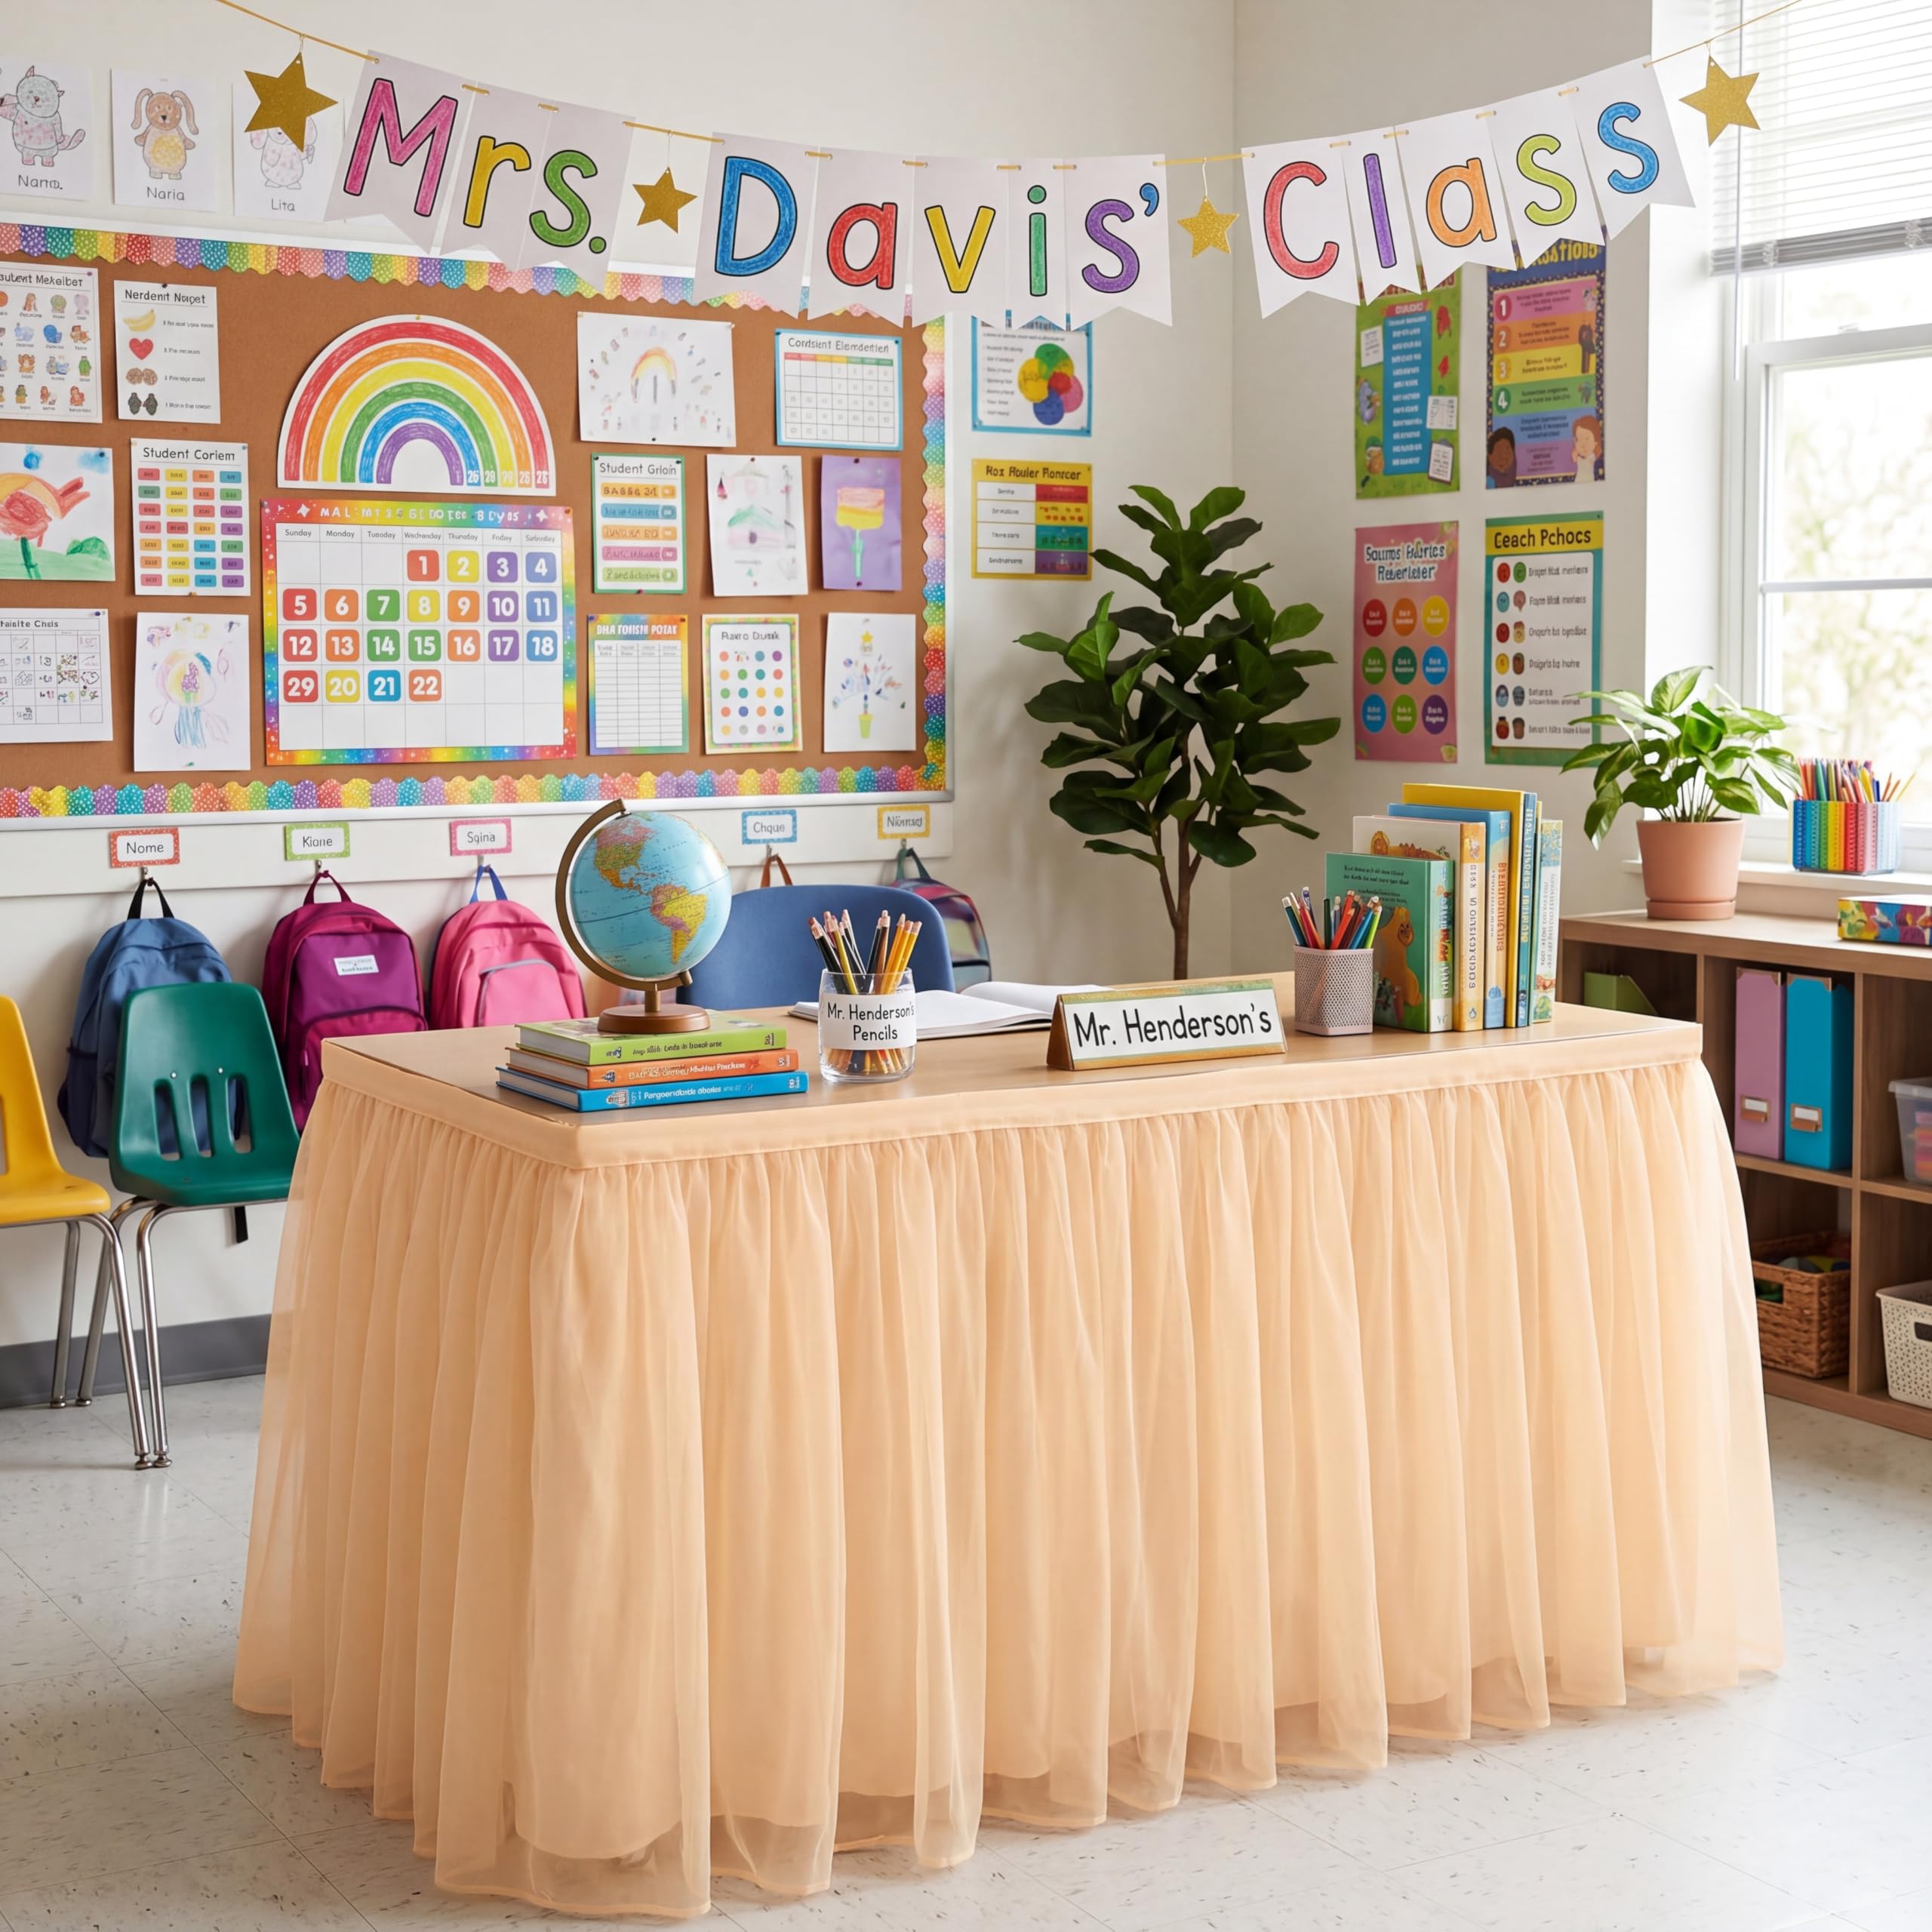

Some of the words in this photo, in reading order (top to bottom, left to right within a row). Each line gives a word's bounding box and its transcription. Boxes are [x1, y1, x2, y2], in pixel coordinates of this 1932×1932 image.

[343, 78, 606, 254] Mrs.
[1263, 102, 1660, 280] Class
[146, 186, 184, 201] Naria
[272, 199, 295, 212] Lita
[1500, 300, 1506, 316] 1
[1499, 331, 1506, 347] 2
[1498, 392, 1508, 408] 4
[143, 447, 189, 460] Student
[600, 463, 643, 474] Student
[285, 529, 312, 537] Sunday
[419, 555, 428, 575] 1
[457, 556, 469, 577] 2
[497, 557, 509, 577] 3
[534, 557, 548, 576] 4
[294, 595, 307, 616] 5
[335, 595, 349, 616] 6
[377, 595, 390, 615] 7
[418, 595, 432, 616] 8
[457, 596, 471, 616] 9
[492, 596, 515, 617] 10
[533, 597, 551, 617] 11
[289, 635, 312, 656] 12
[331, 635, 354, 656] 13
[372, 635, 395, 656] 14
[414, 635, 436, 657] 15
[454, 636, 476, 656] 16
[492, 636, 514, 655] 17
[532, 635, 555, 656] 18
[288, 677, 315, 697] 29
[330, 676, 357, 697] 20
[374, 676, 395, 697] 21
[413, 675, 438, 695] 22
[127, 841, 165, 854] Nome
[827, 1002, 844, 1020] Mr.
[849, 1002, 915, 1021] Henderson's
[853, 1024, 898, 1041] Pencils
[1073, 1011, 1116, 1048] Mr.
[1123, 1003, 1272, 1044] Henderson's
